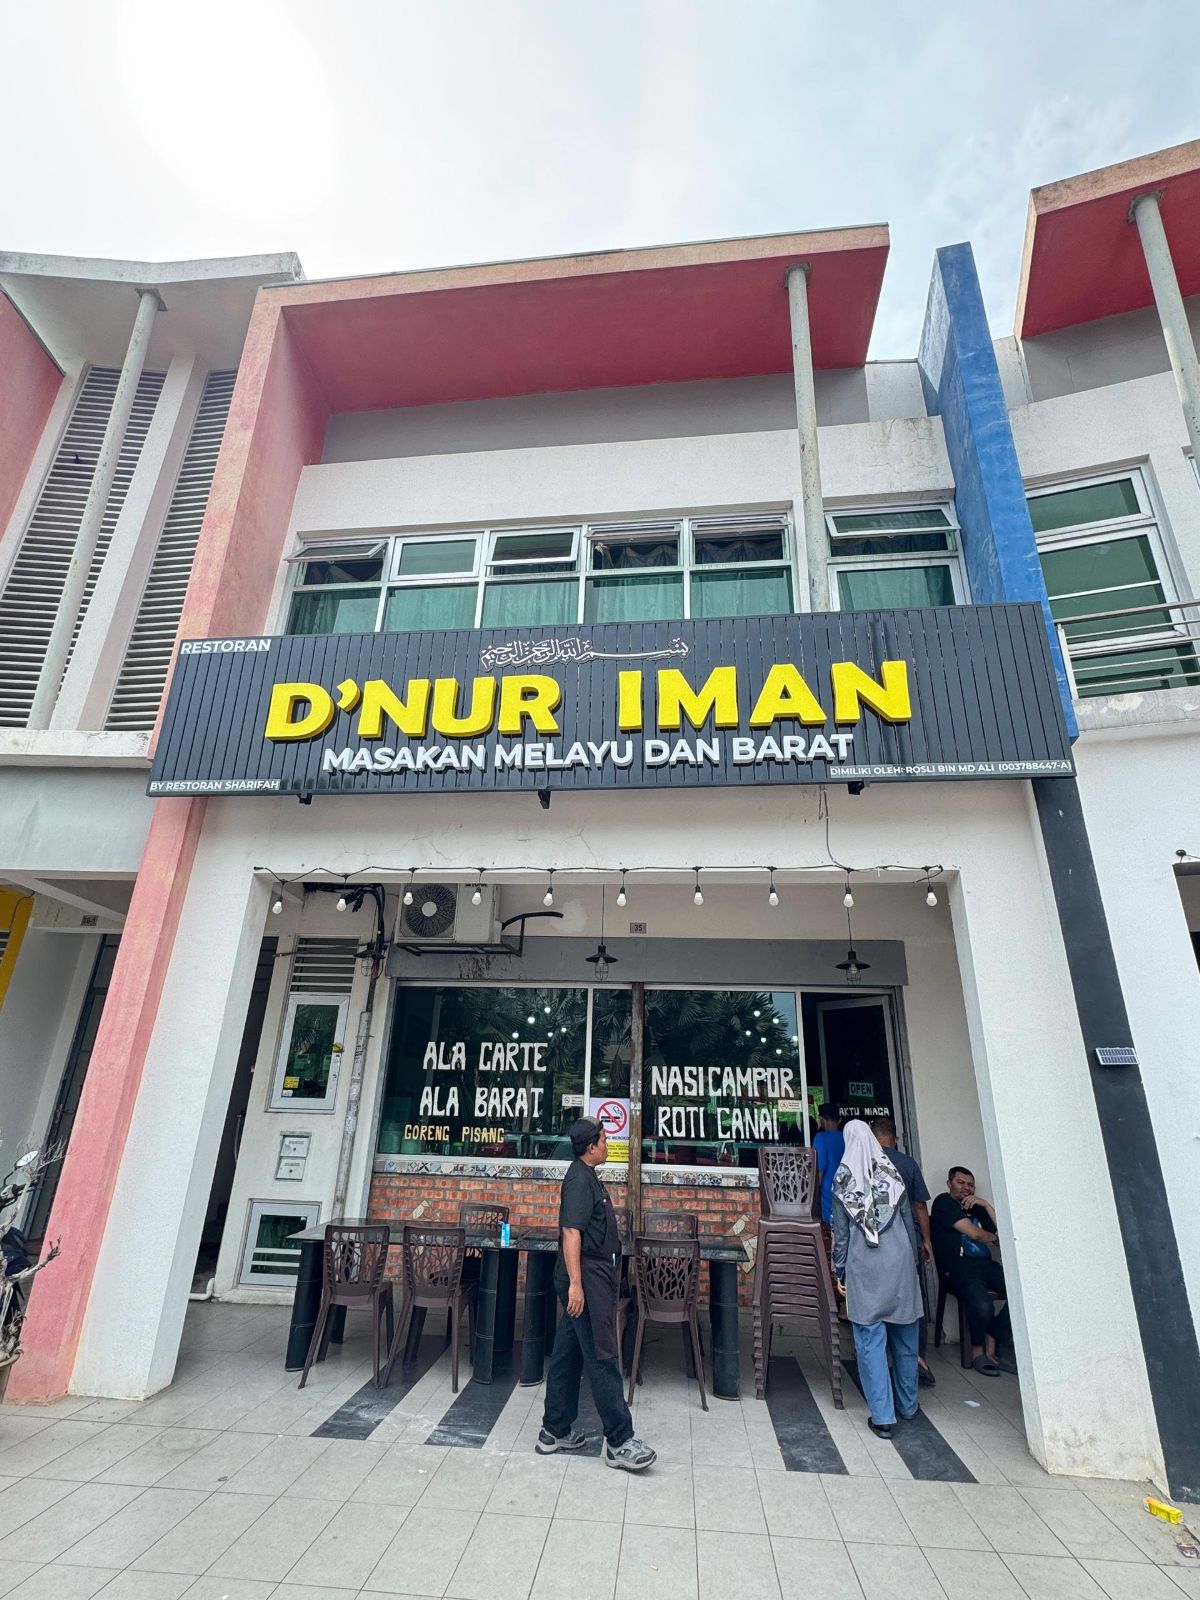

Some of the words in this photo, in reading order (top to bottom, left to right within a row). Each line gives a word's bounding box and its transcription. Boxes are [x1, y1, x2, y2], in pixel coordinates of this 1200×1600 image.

[181, 639, 271, 654] RESTORAN
[265, 674, 561, 741] D'NUR
[618, 660, 912, 731] IMAN
[322, 745, 486, 772] MASAKAN
[494, 740, 633, 769] MELAYU
[645, 738, 720, 766] DAN
[732, 734, 854, 764] BARAT
[830, 767, 871, 776] DIMILIKI
[873, 766, 904, 775] OLEH:
[905, 764, 936, 774] ROSLI
[938, 765, 957, 773] BIN
[959, 764, 976, 773] MD
[978, 763, 995, 772] ALI
[150, 782, 164, 791] BY
[165, 780, 222, 791] RESTORAN
[224, 779, 280, 790] SHARIFAH
[634, 924, 643, 932] 35
[423, 1041, 467, 1070] ALA
[479, 1042, 549, 1072] CARTE
[651, 1065, 704, 1097] NASI
[850, 1083, 873, 1096] OPEN
[419, 1086, 460, 1117] ALA
[474, 1087, 545, 1118] BARAT
[839, 1106, 860, 1117] AKTU
[864, 1107, 890, 1117] NIAGA
[658, 1106, 706, 1139] ROTI
[716, 1107, 780, 1140] CANAI
[404, 1124, 450, 1141] GORENG
[462, 1126, 505, 1143] PISANG
